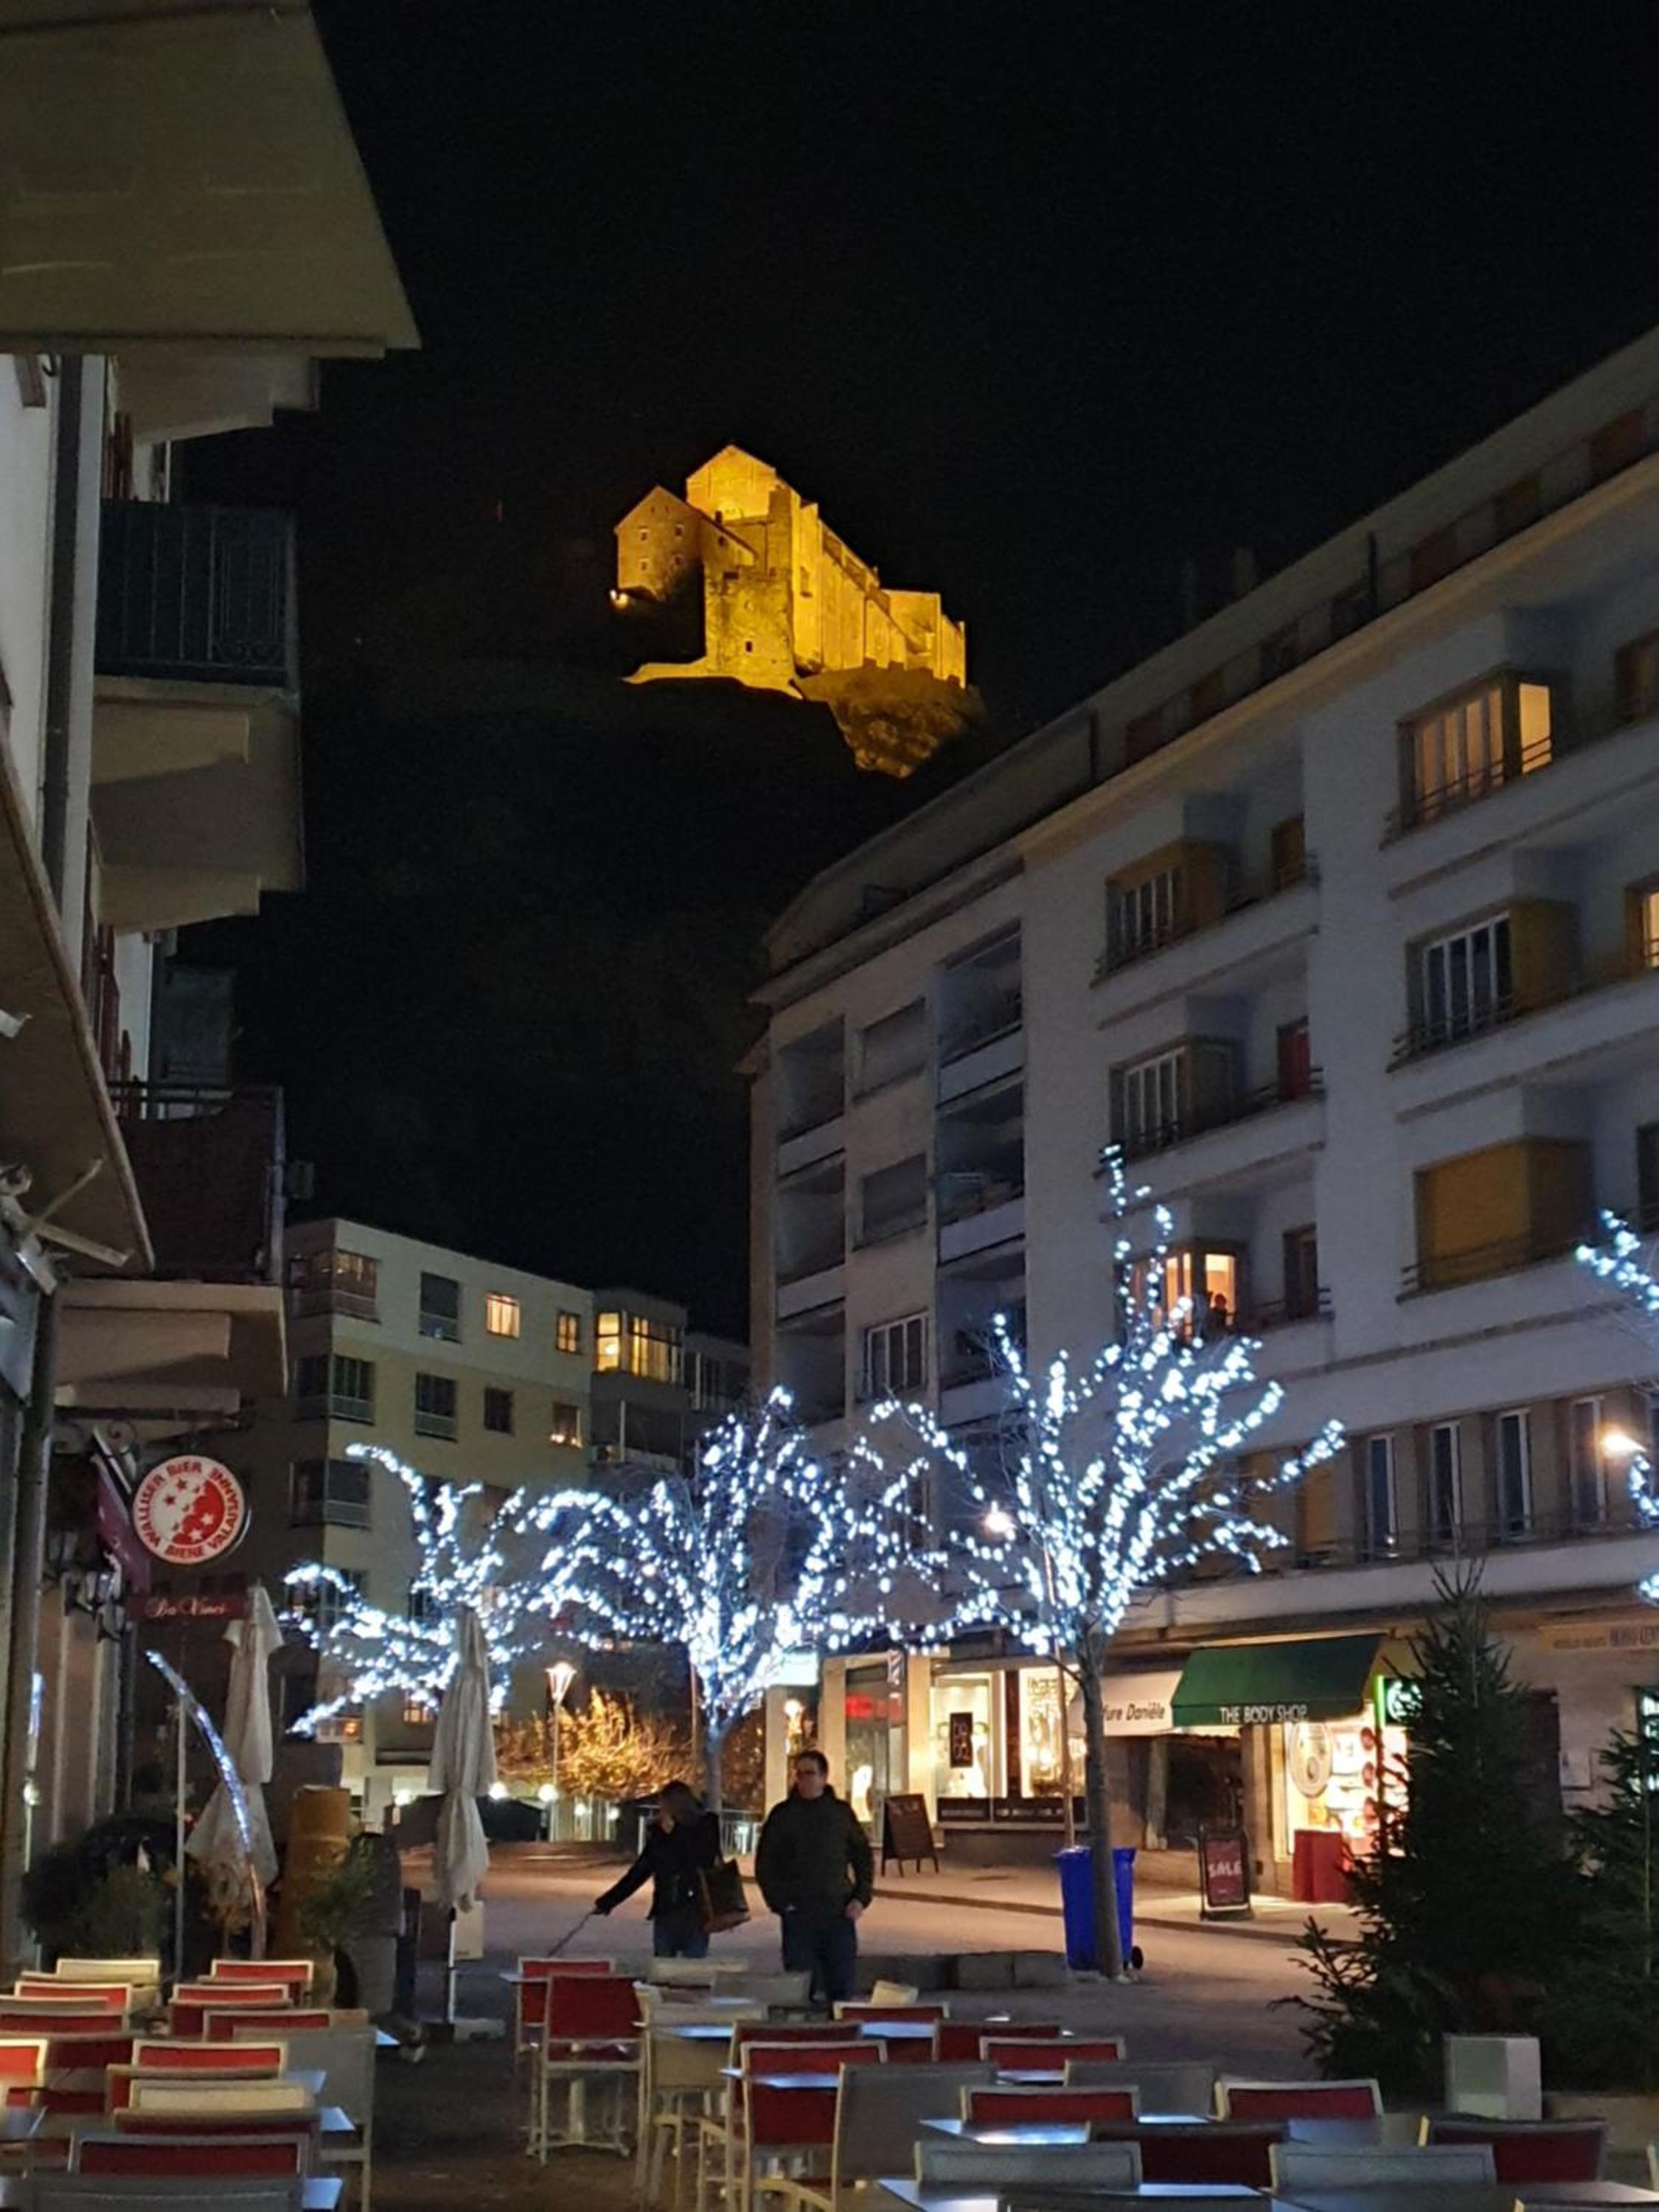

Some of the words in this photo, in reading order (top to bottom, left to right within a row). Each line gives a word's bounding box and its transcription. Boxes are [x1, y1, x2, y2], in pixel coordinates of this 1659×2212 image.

[1219, 1705, 1240, 1724] THE
[1243, 1705, 1275, 1724] BODY
[1276, 1703, 1307, 1723] SHOP
[1207, 1859, 1243, 1878] SALE
